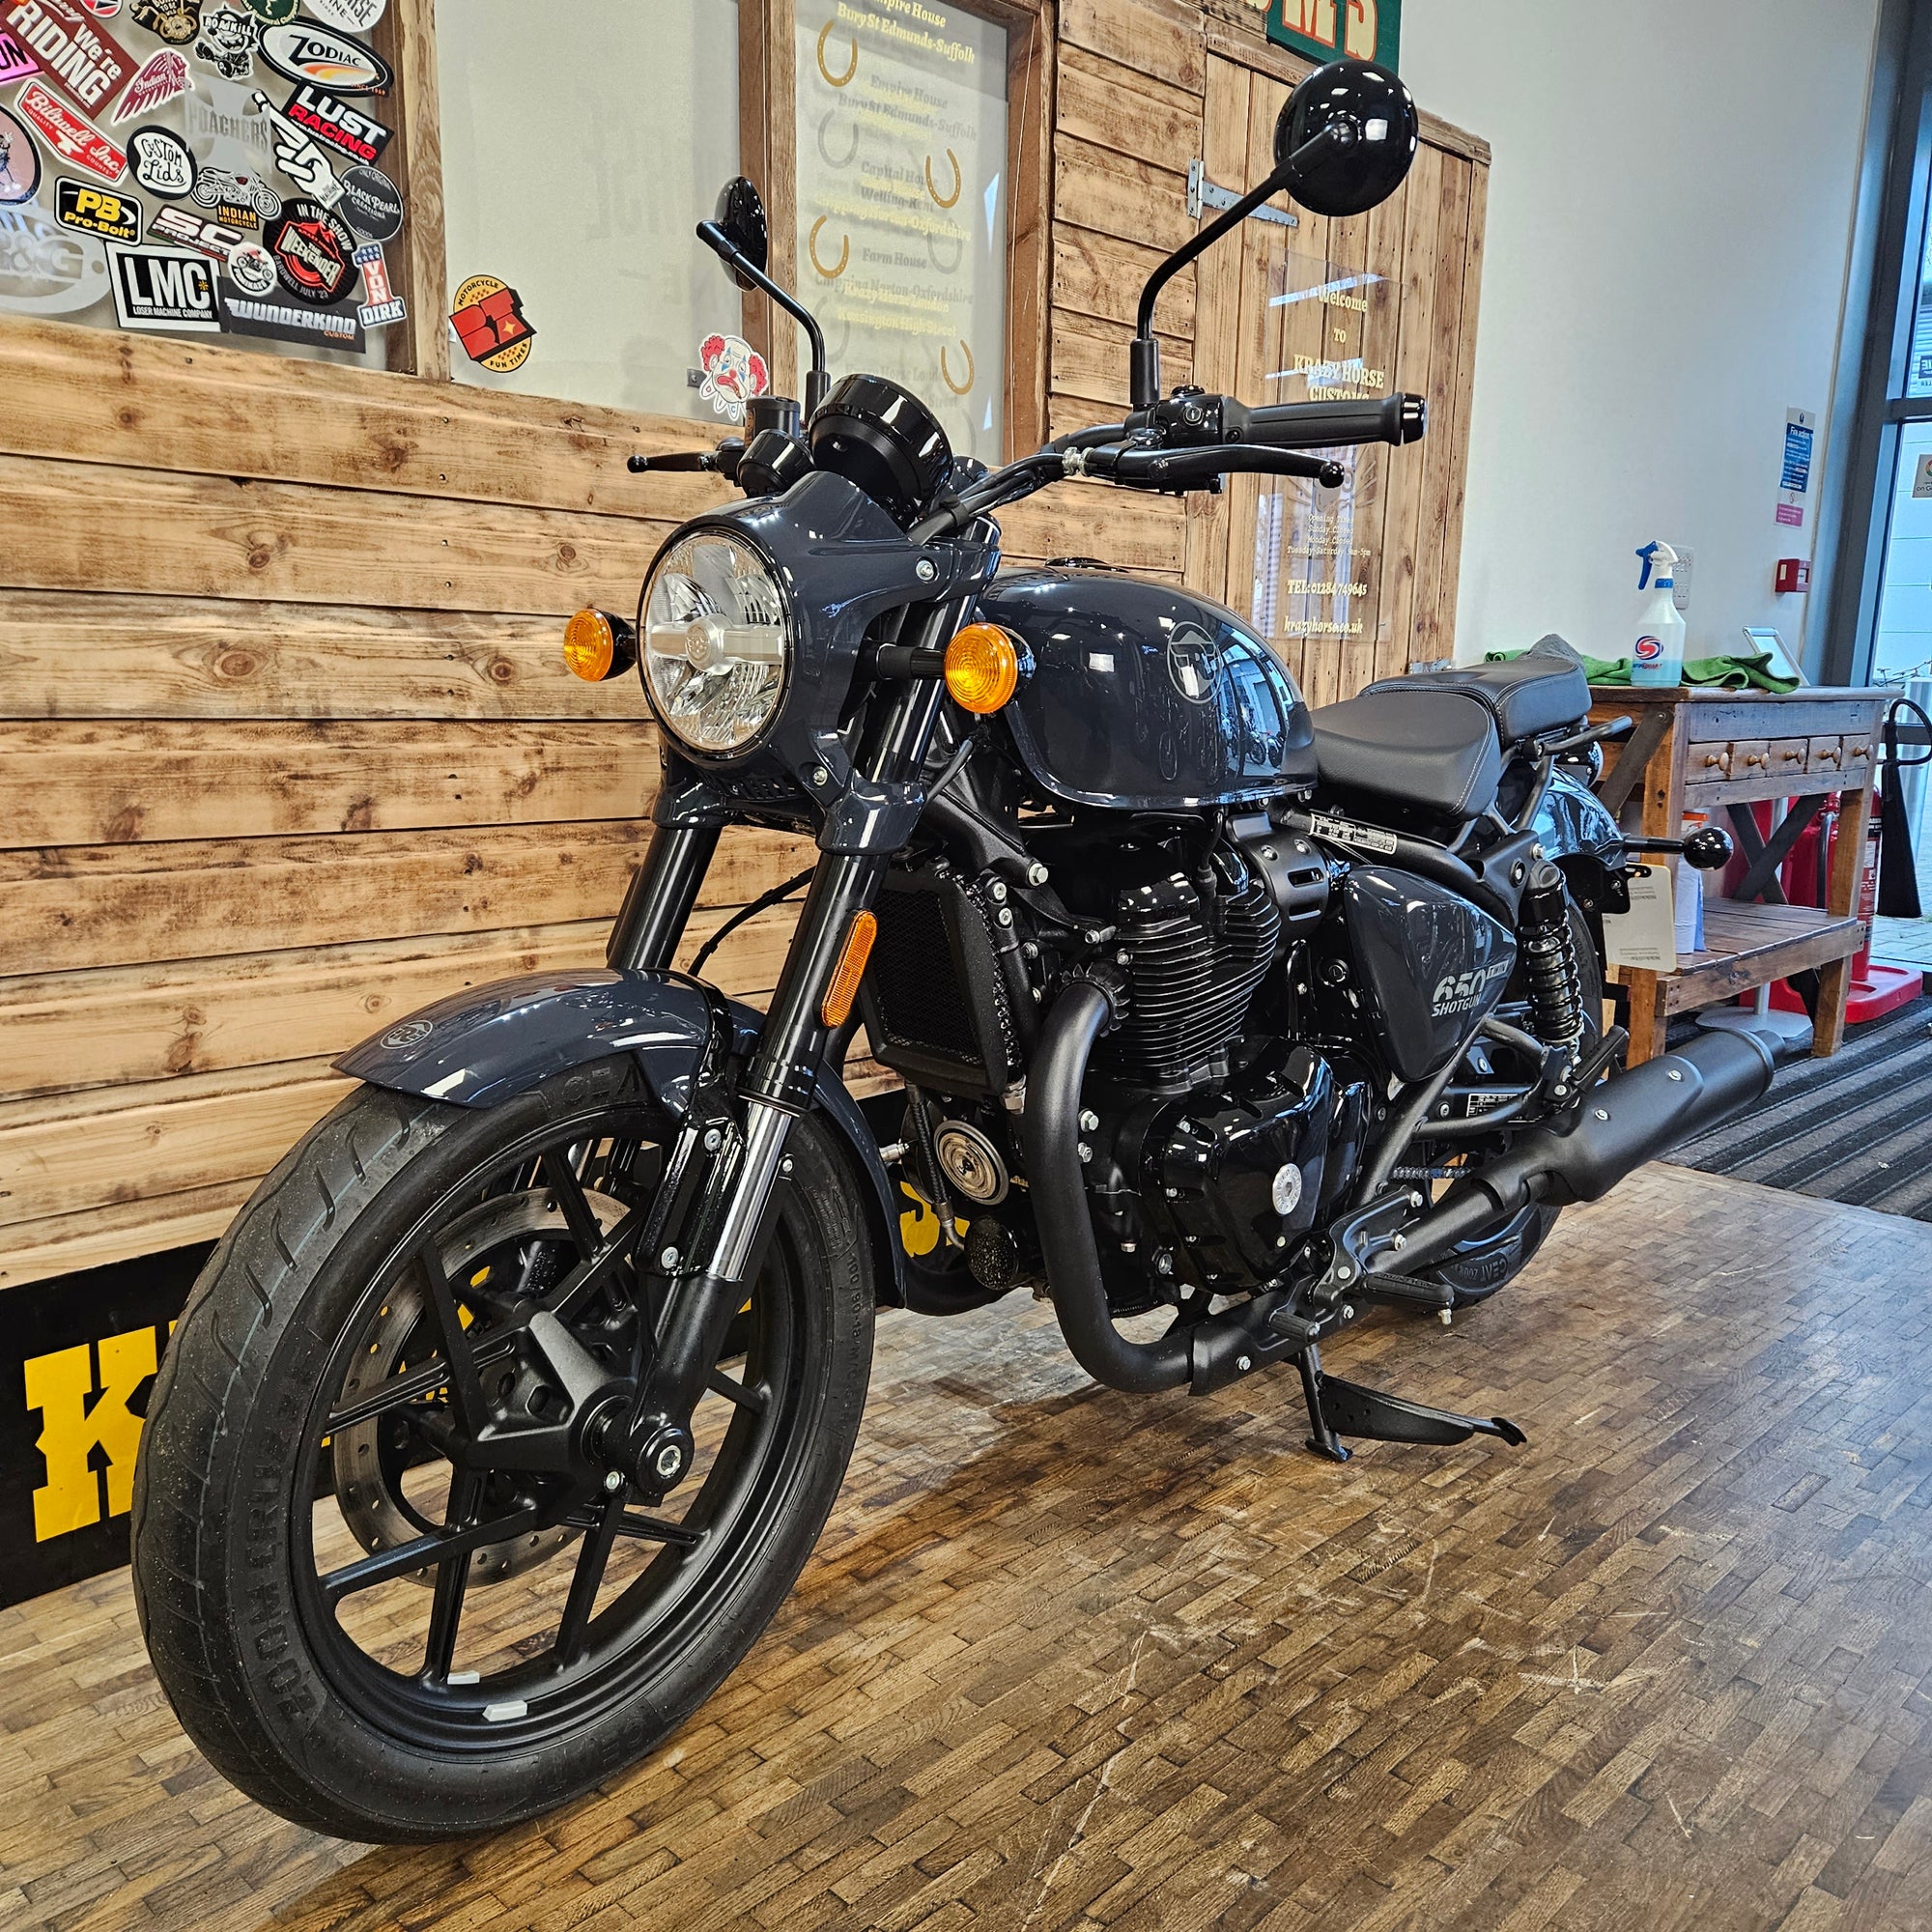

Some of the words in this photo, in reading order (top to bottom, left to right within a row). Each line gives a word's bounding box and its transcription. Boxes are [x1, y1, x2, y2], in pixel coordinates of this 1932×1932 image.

[837, 1, 868, 29] Bury
[867, 13, 881, 30] St
[7, 0, 105, 105] RIDING
[73, 22, 123, 81] We're
[289, 34, 361, 67] ZODIAC
[25, 91, 95, 148] Biltwell
[297, 85, 386, 145] LUST
[288, 102, 378, 161] RACING
[75, 187, 122, 222] PB
[343, 179, 372, 206] BLACK
[371, 195, 401, 214] PEARL
[217, 205, 257, 222] INDIAN
[218, 216, 258, 229] MOTORCYCLE
[297, 204, 309, 217] IN
[309, 205, 330, 225] THE
[328, 218, 354, 251] SHOW
[280, 225, 342, 288] WEEKENDER
[124, 257, 212, 311] LMC
[300, 286, 317, 299] JULY
[458, 279, 499, 306] MOTORCYCLE
[132, 305, 154, 317] LOSER
[154, 307, 182, 319] MACHINE
[182, 308, 213, 320] COMPANY
[361, 300, 403, 325] DIRK
[1318, 285, 1368, 313] Welcome
[224, 297, 356, 335] WUNDERKIND
[324, 329, 355, 340] CUSTOM
[1333, 327, 1347, 344] TO
[509, 342, 527, 366] TIMES
[1342, 363, 1384, 389] HORSE
[1283, 615, 1364, 639] krazyhorse.co.uk
[1433, 969, 1487, 1003] 650
[1432, 992, 1482, 1017] SHOTGUN
